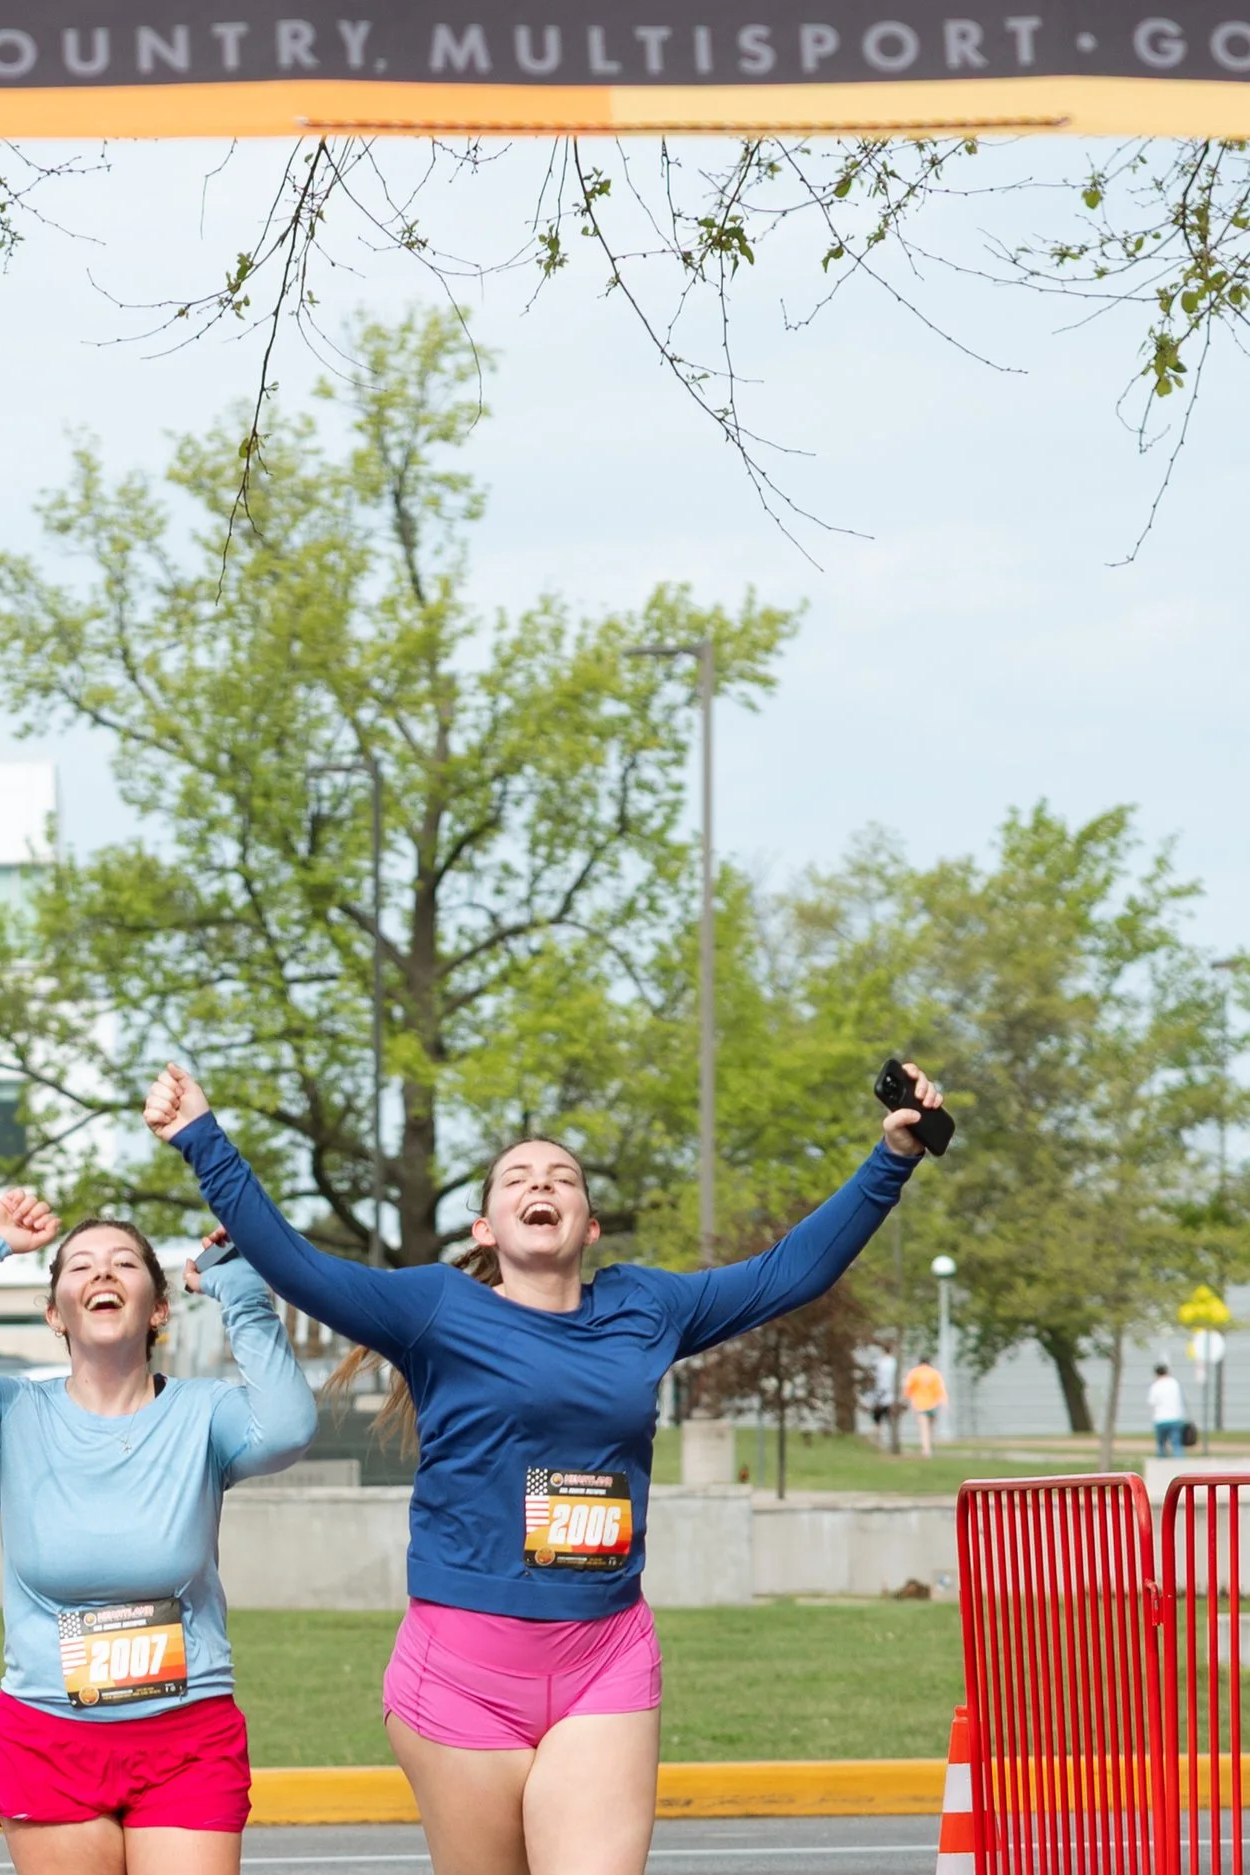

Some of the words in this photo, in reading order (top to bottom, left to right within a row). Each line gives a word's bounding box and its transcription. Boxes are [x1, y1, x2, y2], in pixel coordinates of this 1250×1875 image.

[428, 15, 1044, 76] MULTISPORT
[547, 1503, 622, 1547] 2006
[88, 1633, 168, 1684] 2007
